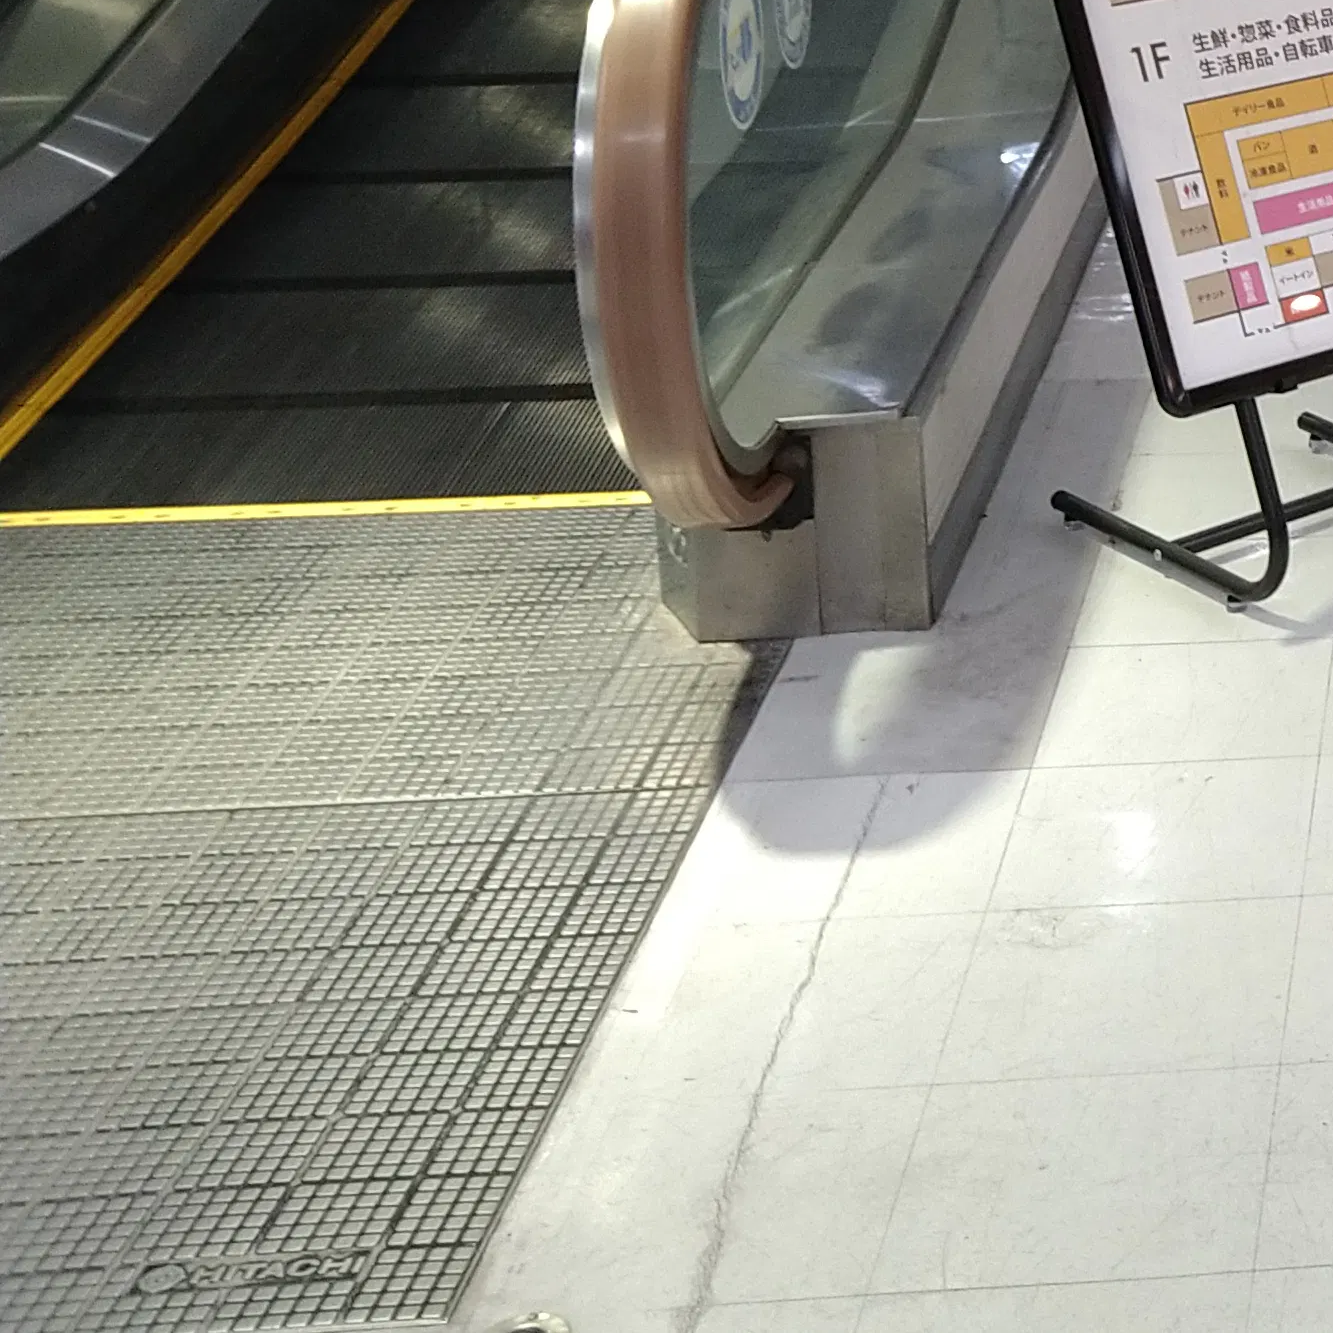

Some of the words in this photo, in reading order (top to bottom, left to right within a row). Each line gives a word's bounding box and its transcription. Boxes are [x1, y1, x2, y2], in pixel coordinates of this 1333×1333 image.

[1130, 41, 1171, 83] 1F
[1278, 269, 1314, 285] イートイン
[188, 1254, 367, 1285] HITACHI
